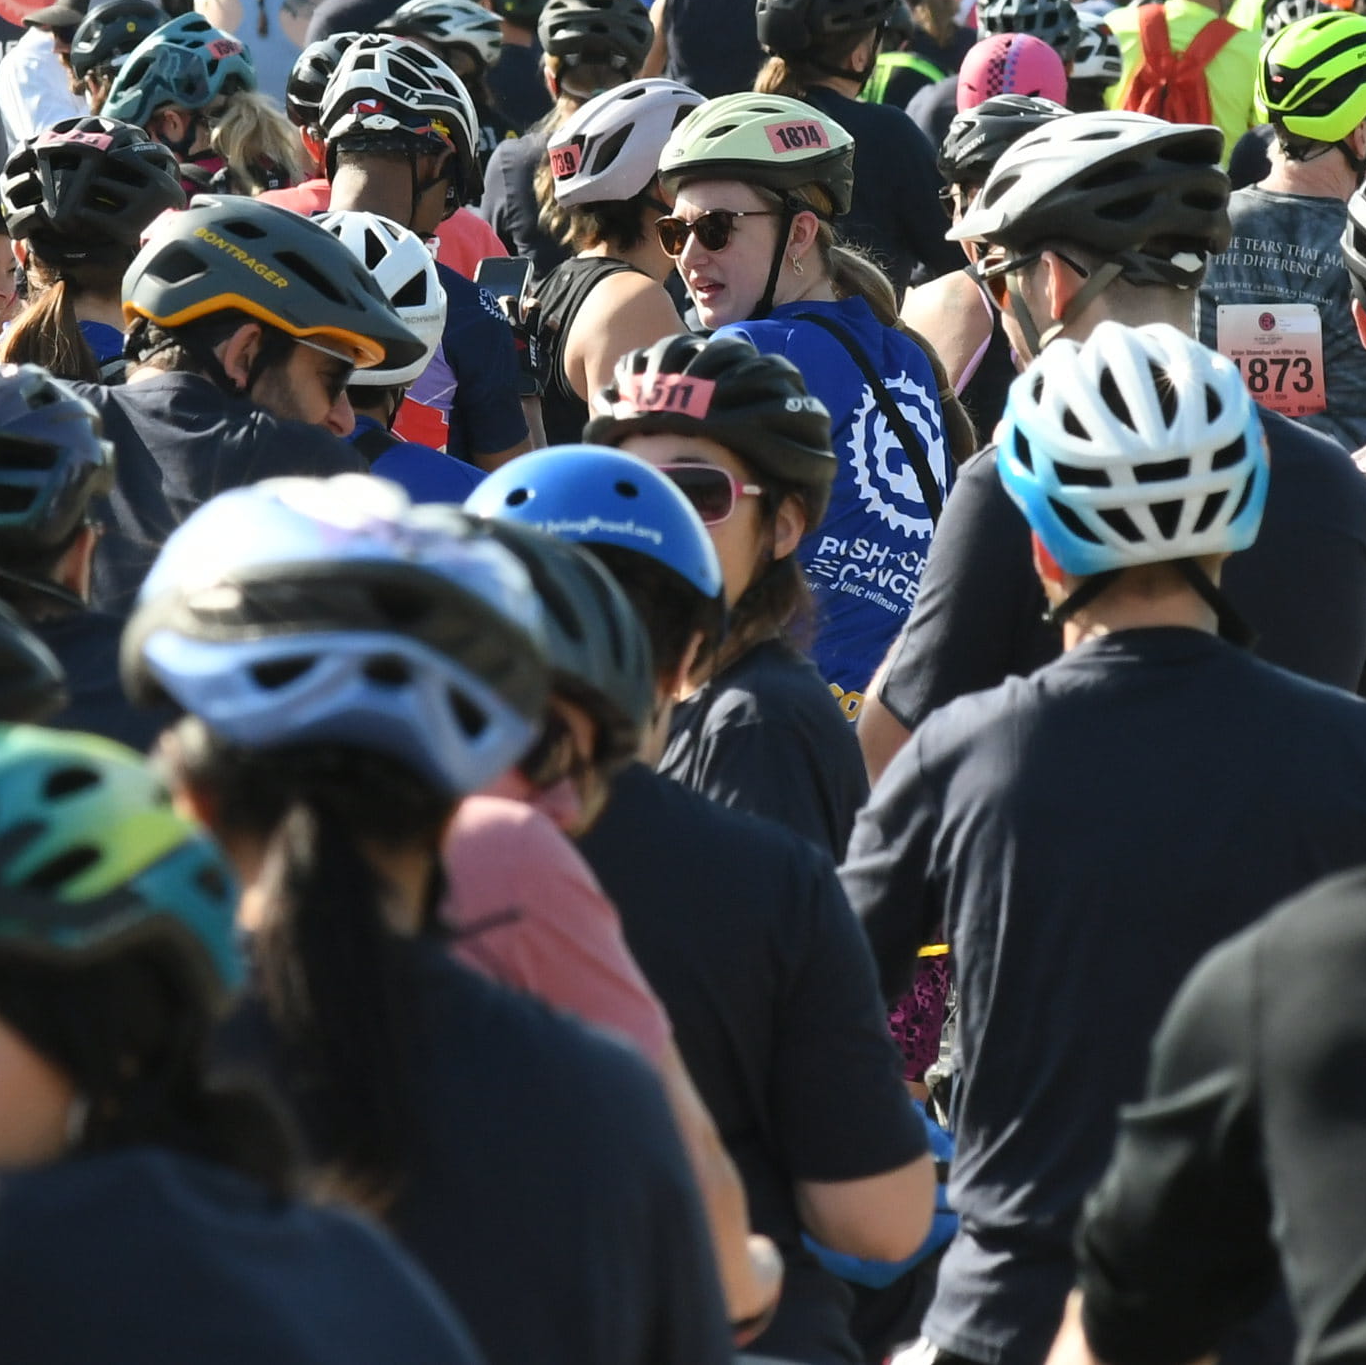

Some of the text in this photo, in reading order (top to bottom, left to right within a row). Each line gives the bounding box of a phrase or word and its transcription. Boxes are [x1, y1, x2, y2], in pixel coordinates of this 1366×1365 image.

[775, 124, 822, 151] 1874
[193, 226, 289, 289] BONTRAGER
[1214, 252, 1240, 266] THE
[1245, 237, 1283, 254] TEARS
[1286, 243, 1320, 261] THAT
